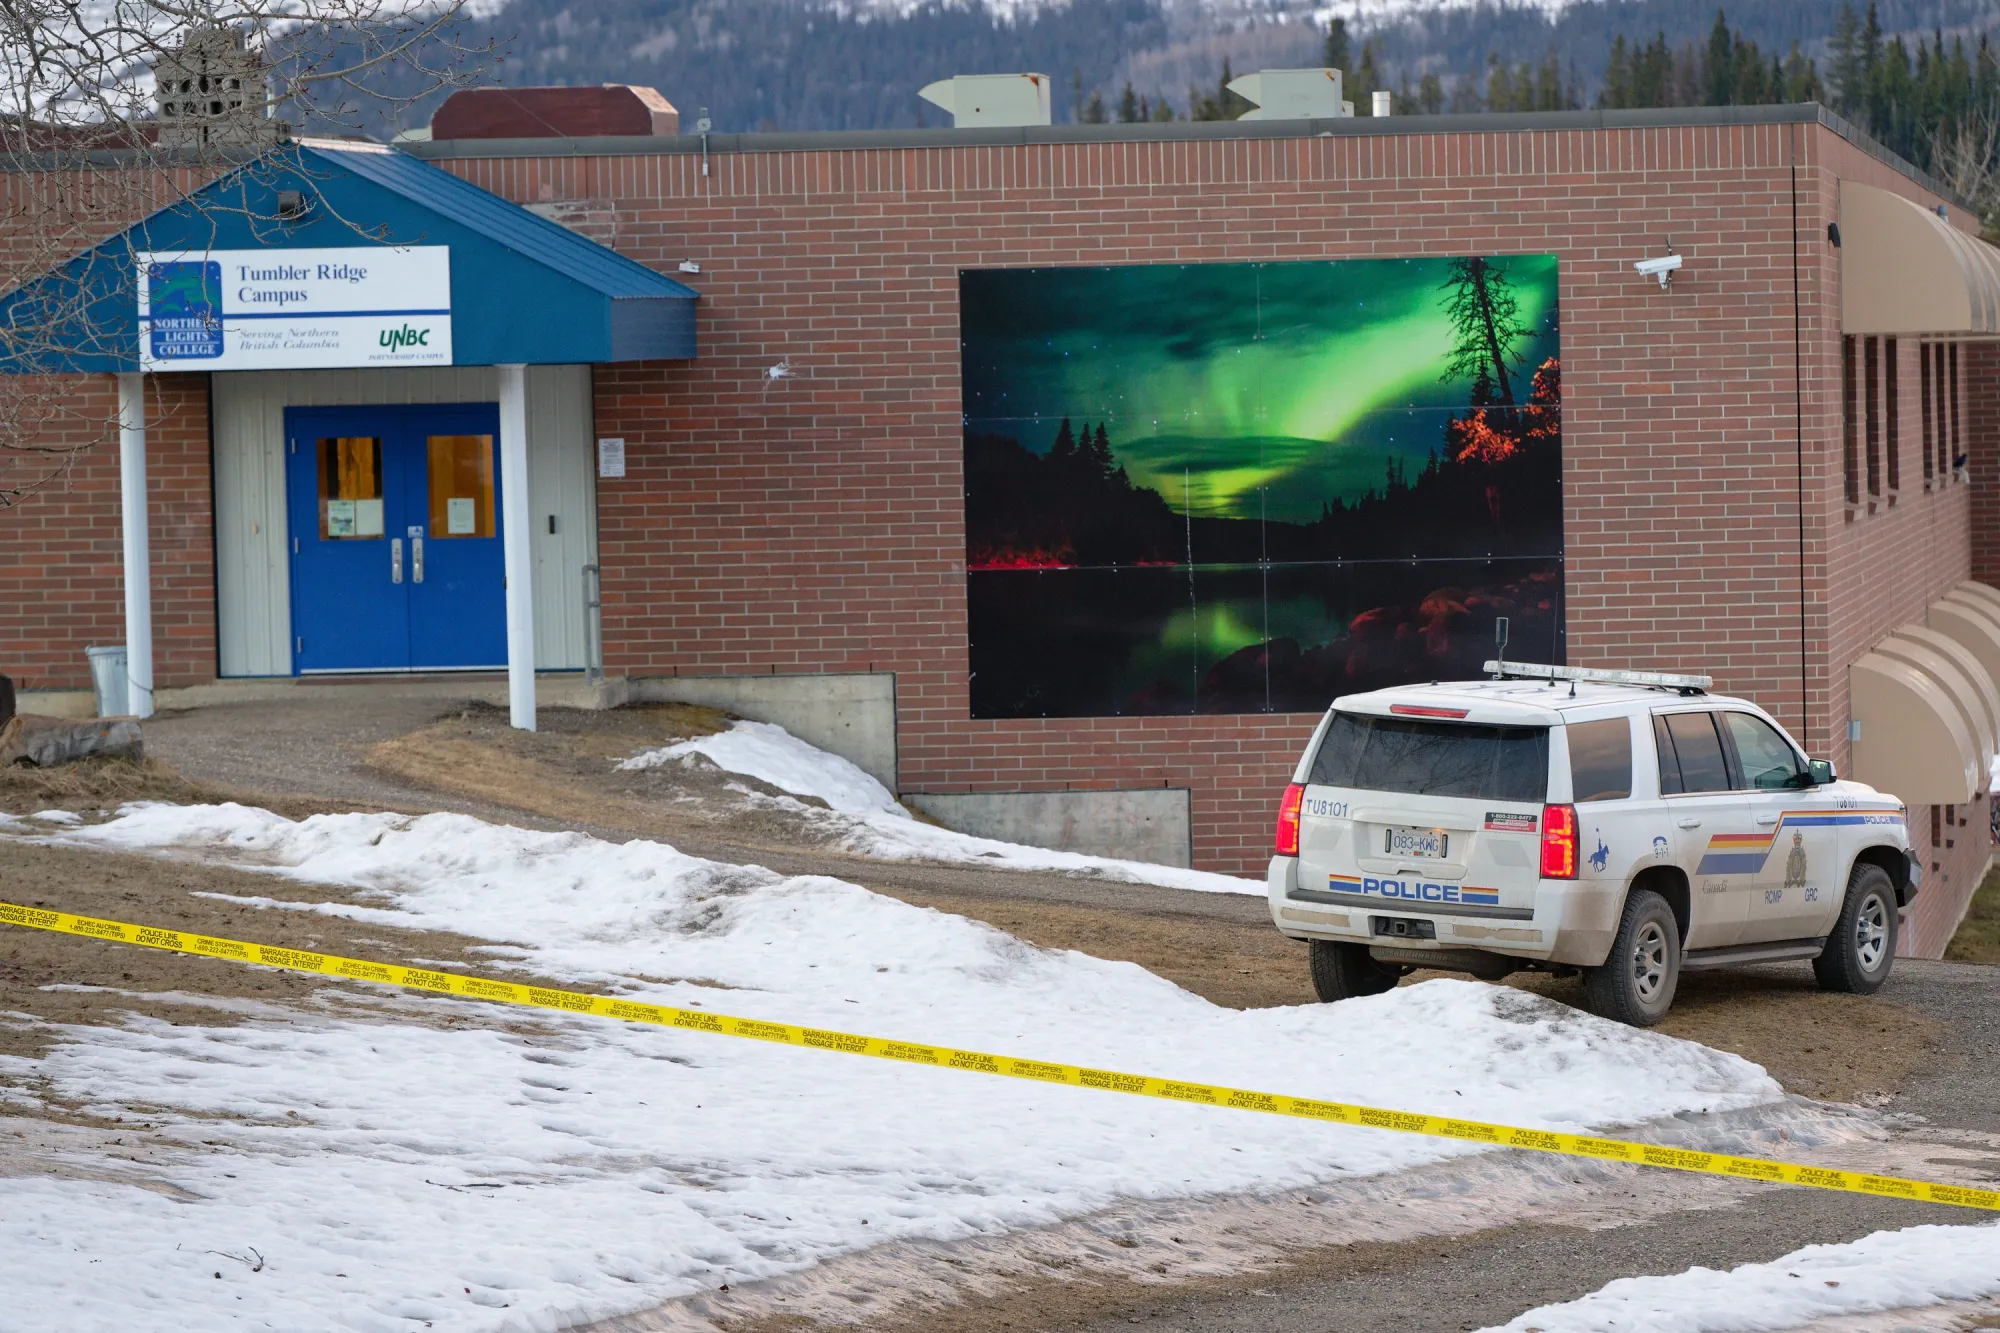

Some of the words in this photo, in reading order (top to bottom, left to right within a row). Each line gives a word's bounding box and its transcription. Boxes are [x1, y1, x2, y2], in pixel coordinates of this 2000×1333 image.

[236, 264, 311, 283] Tumbler
[317, 263, 367, 283] Ridge
[238, 286, 308, 306] Campus
[165, 331, 210, 342] LIGHTS
[238, 327, 283, 341] Serving
[288, 326, 339, 338] Northern
[379, 323, 431, 352] UNBC
[159, 344, 216, 355] COLLEGE
[240, 339, 279, 350] British
[283, 337, 340, 350] Columbia
[1306, 798, 1349, 817] TU8101
[1864, 815, 1891, 824] POLICE
[1363, 878, 1460, 902] POLICE
[1702, 878, 1728, 894] Canada
[1765, 889, 1782, 904] RCMP
[1805, 887, 1818, 901] GRC
[0, 905, 26, 915] ARRAGE
[26, 909, 35, 917] DE
[36, 911, 59, 920] POLICE
[27, 916, 55, 927] INTERDIT
[105, 923, 120, 931] CRIME
[135, 934, 144, 942] DO
[145, 936, 159, 944] NOT
[160, 938, 182, 948] CROSS
[140, 928, 163, 938] POLICE
[163, 931, 178, 940] LINE
[197, 938, 214, 946] CRIME
[215, 941, 243, 950] STOPPERS
[259, 946, 290, 957] BARRAGE
[291, 951, 300, 959] DE
[301, 953, 324, 963] POLICE
[261, 953, 290, 965] PASSAGE
[292, 958, 321, 970] INTERDIT
[371, 965, 387, 973] CRIME
[407, 970, 430, 980] POLICE
[431, 974, 445, 982] LINE
[402, 976, 411, 984] DO
[412, 978, 426, 987] NOT
[427, 980, 450, 990] CROSS
[465, 980, 482, 988] CRIME
[483, 983, 512, 992] STOPPERS
[529, 988, 560, 999] BARRAGE
[561, 993, 570, 1001] DE
[571, 995, 594, 1005] POLICE
[530, 995, 560, 1007] PASSAGE
[562, 1000, 591, 1012] INTERDIT
[641, 1007, 658, 1015] CRIME
[679, 1011, 702, 1021] POLICE
[703, 1015, 717, 1023] LINE
[674, 1018, 683, 1026] DO
[685, 1019, 698, 1028] NOT
[700, 1021, 722, 1032] CROSS
[738, 1021, 755, 1029] CRIME
[756, 1024, 785, 1033] STOPPERS
[802, 1029, 833, 1041] BARRAGE
[835, 1034, 843, 1042] DE
[845, 1036, 868, 1046] POLICE
[803, 1037, 833, 1048] PASSAGE
[836, 1042, 865, 1053] INTERDIT
[916, 1048, 933, 1056] CRIME
[954, 1051, 977, 1061] POLICE
[979, 1055, 993, 1064] LINE
[949, 1058, 958, 1066] DO
[960, 1060, 974, 1069] NOT
[975, 1062, 998, 1072] CROSS
[1013, 1061, 1031, 1069] CRIME
[1032, 1063, 1062, 1073] STOPPERS
[1079, 1069, 1110, 1080] BARRAGE
[1111, 1074, 1120, 1082] DE
[1122, 1075, 1146, 1085] POLICE
[1080, 1077, 1110, 1088] PASSAGE
[1112, 1081, 1142, 1092] INTERDIT
[1195, 1087, 1212, 1095] CRIME
[1233, 1091, 1256, 1101] POLICE
[1258, 1094, 1272, 1103] LINE
[1228, 1098, 1237, 1106] DO
[1238, 1099, 1252, 1108] NOT
[1254, 1101, 1277, 1111] CROSS
[1293, 1100, 1310, 1108] CRIME
[1311, 1103, 1341, 1112] STOPPERS
[1359, 1108, 1391, 1119] BARRAGE
[1392, 1113, 1401, 1121] DE
[1403, 1114, 1427, 1124] POLICE
[1360, 1116, 1391, 1127] PASSAGE
[1393, 1121, 1424, 1131] INTERDIT
[1476, 1126, 1494, 1134] CRIME
[1515, 1129, 1538, 1139] POLICE
[1540, 1133, 1555, 1141] LINE
[1510, 1136, 1520, 1145] DO
[1521, 1138, 1535, 1147] NOT
[1536, 1140, 1560, 1150] CROSS
[1576, 1139, 1593, 1147] CRIME
[1595, 1141, 1625, 1151] STOPPERS
[1643, 1147, 1675, 1157] BARRAGE
[1677, 1151, 1685, 1159] DE
[1688, 1152, 1712, 1162] POLICE
[1645, 1154, 1675, 1165] PASSAGE
[1678, 1159, 1708, 1170] INTERDIT
[1801, 1167, 1824, 1177] POLICE
[1826, 1171, 1840, 1179] LINE
[1795, 1174, 1805, 1182] DO
[1806, 1176, 1821, 1185] NOT
[1822, 1178, 1845, 1188] CROSS
[1974, 1190, 1998, 1201] POLICE
